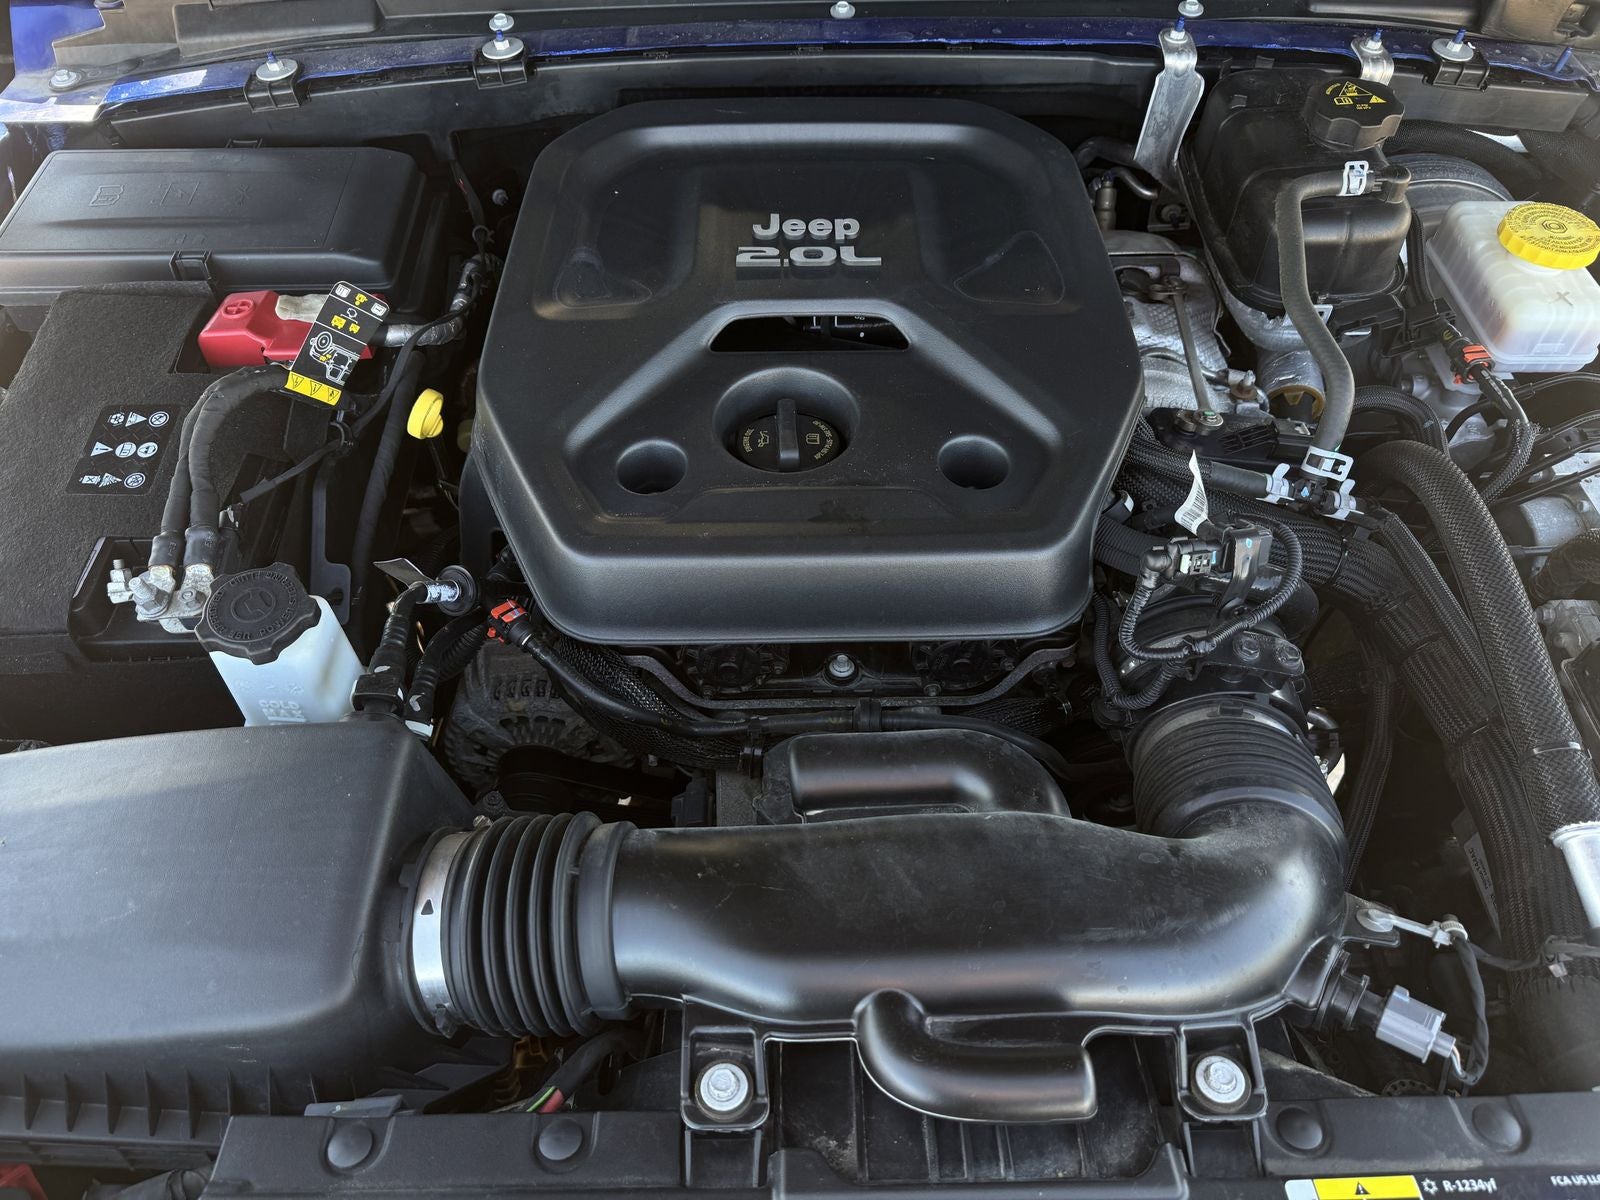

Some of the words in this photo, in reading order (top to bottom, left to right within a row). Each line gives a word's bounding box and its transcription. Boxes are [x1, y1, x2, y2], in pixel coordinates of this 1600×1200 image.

[752, 213, 860, 243] Jeep
[735, 246, 882, 267] 2.0L
[265, 571, 297, 606] STEERING
[259, 607, 295, 638] POWER
[258, 699, 301, 710] COLD
[1442, 1177, 1498, 1194] R-1234yf
[1550, 1175, 1573, 1187] FCA
[1570, 1174, 1588, 1187] US
